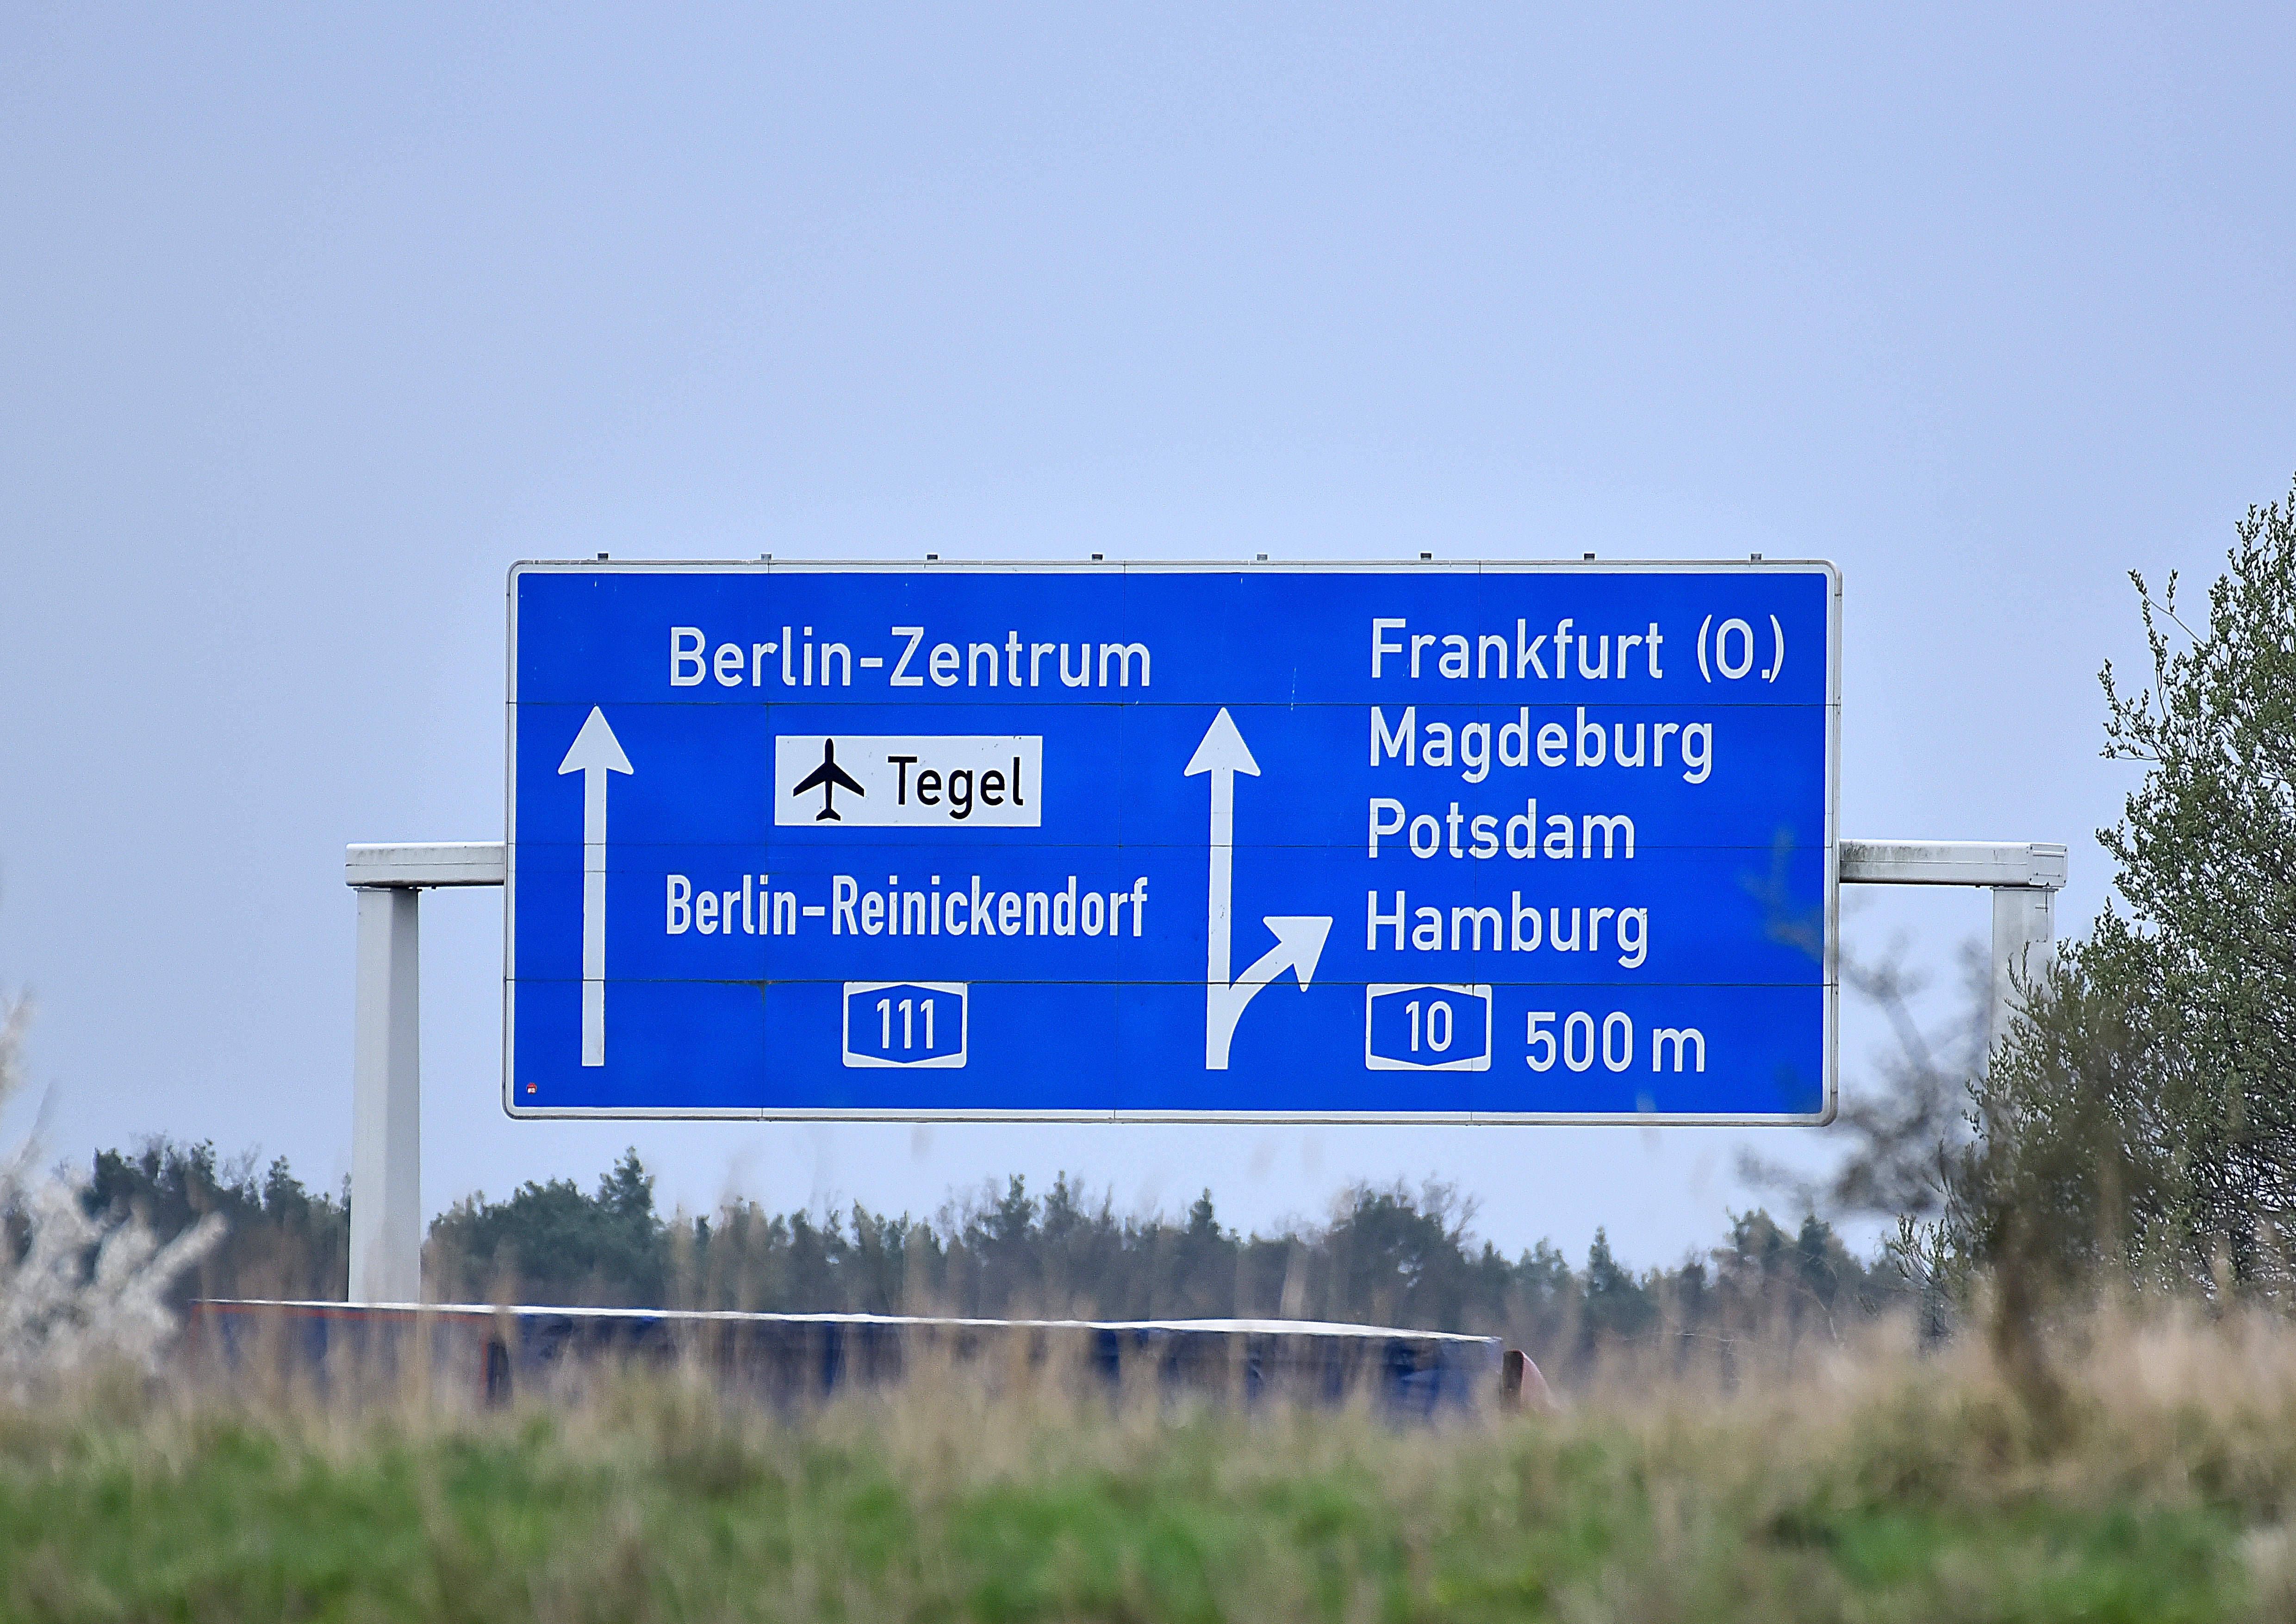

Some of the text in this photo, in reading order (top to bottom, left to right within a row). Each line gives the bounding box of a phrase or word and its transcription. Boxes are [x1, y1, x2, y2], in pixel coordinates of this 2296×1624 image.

[670, 626, 1151, 687] Berlin-Zentrum
[1371, 614, 1785, 683] Frankfurt (O.)
[1370, 706, 1712, 784] Magdeburg
[888, 756, 1024, 819] Tegel
[1368, 798, 1635, 859] Potsdam
[666, 874, 1148, 937] Berlin-Reinickendorf
[1366, 890, 1648, 969] Hamburg
[877, 999, 934, 1049] 111
[1405, 1000, 1453, 1052] 10
[1526, 1011, 1705, 1073] 500 m
